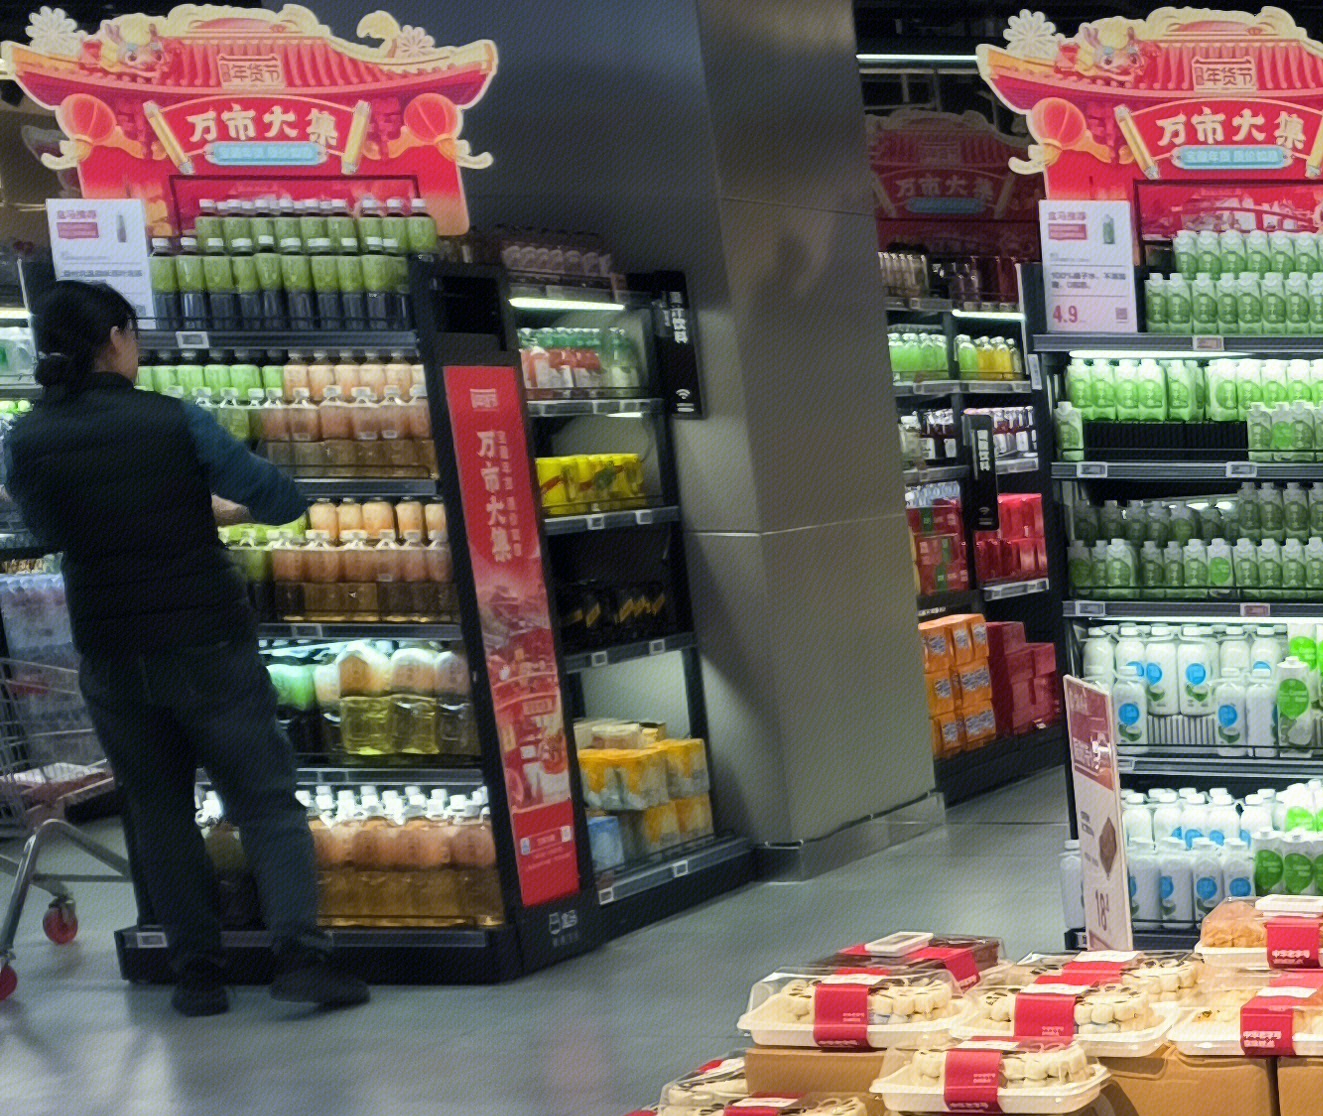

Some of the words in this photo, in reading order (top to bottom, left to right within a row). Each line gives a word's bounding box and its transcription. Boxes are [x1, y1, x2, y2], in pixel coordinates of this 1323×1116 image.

[1205, 66, 1253, 86] 年货节
[185, 102, 338, 146] 万市大集
[1155, 105, 1306, 150] 万市大集
[1053, 305, 1078, 323] 4.9
[476, 428, 512, 563] 万市大集
